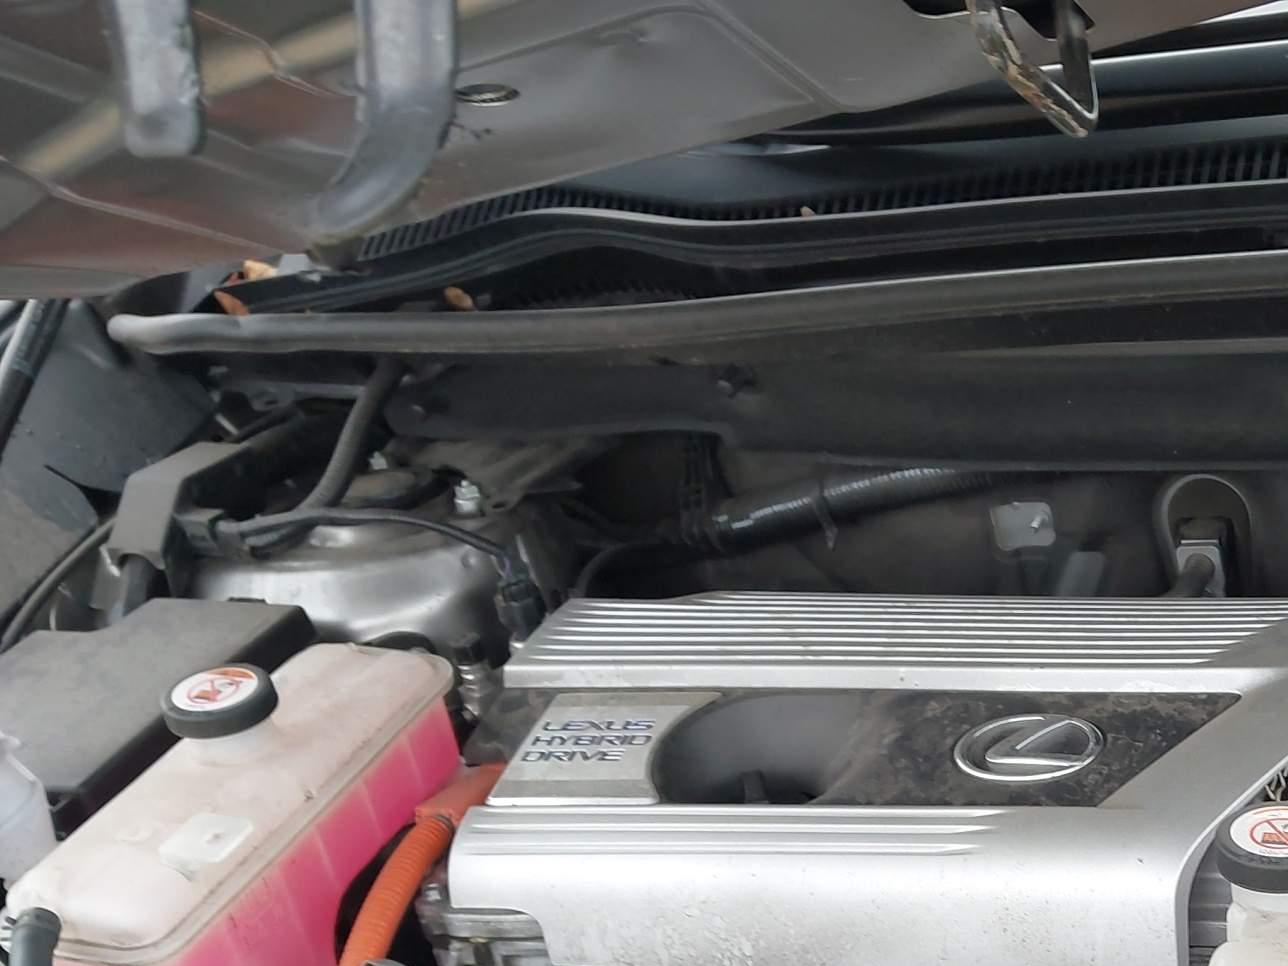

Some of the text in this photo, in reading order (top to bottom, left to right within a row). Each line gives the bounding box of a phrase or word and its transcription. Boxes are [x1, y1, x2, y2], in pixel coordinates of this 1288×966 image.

[542, 720, 657, 731] LEXUS
[531, 735, 653, 746] HYBRID
[520, 750, 626, 762] DRIVE
